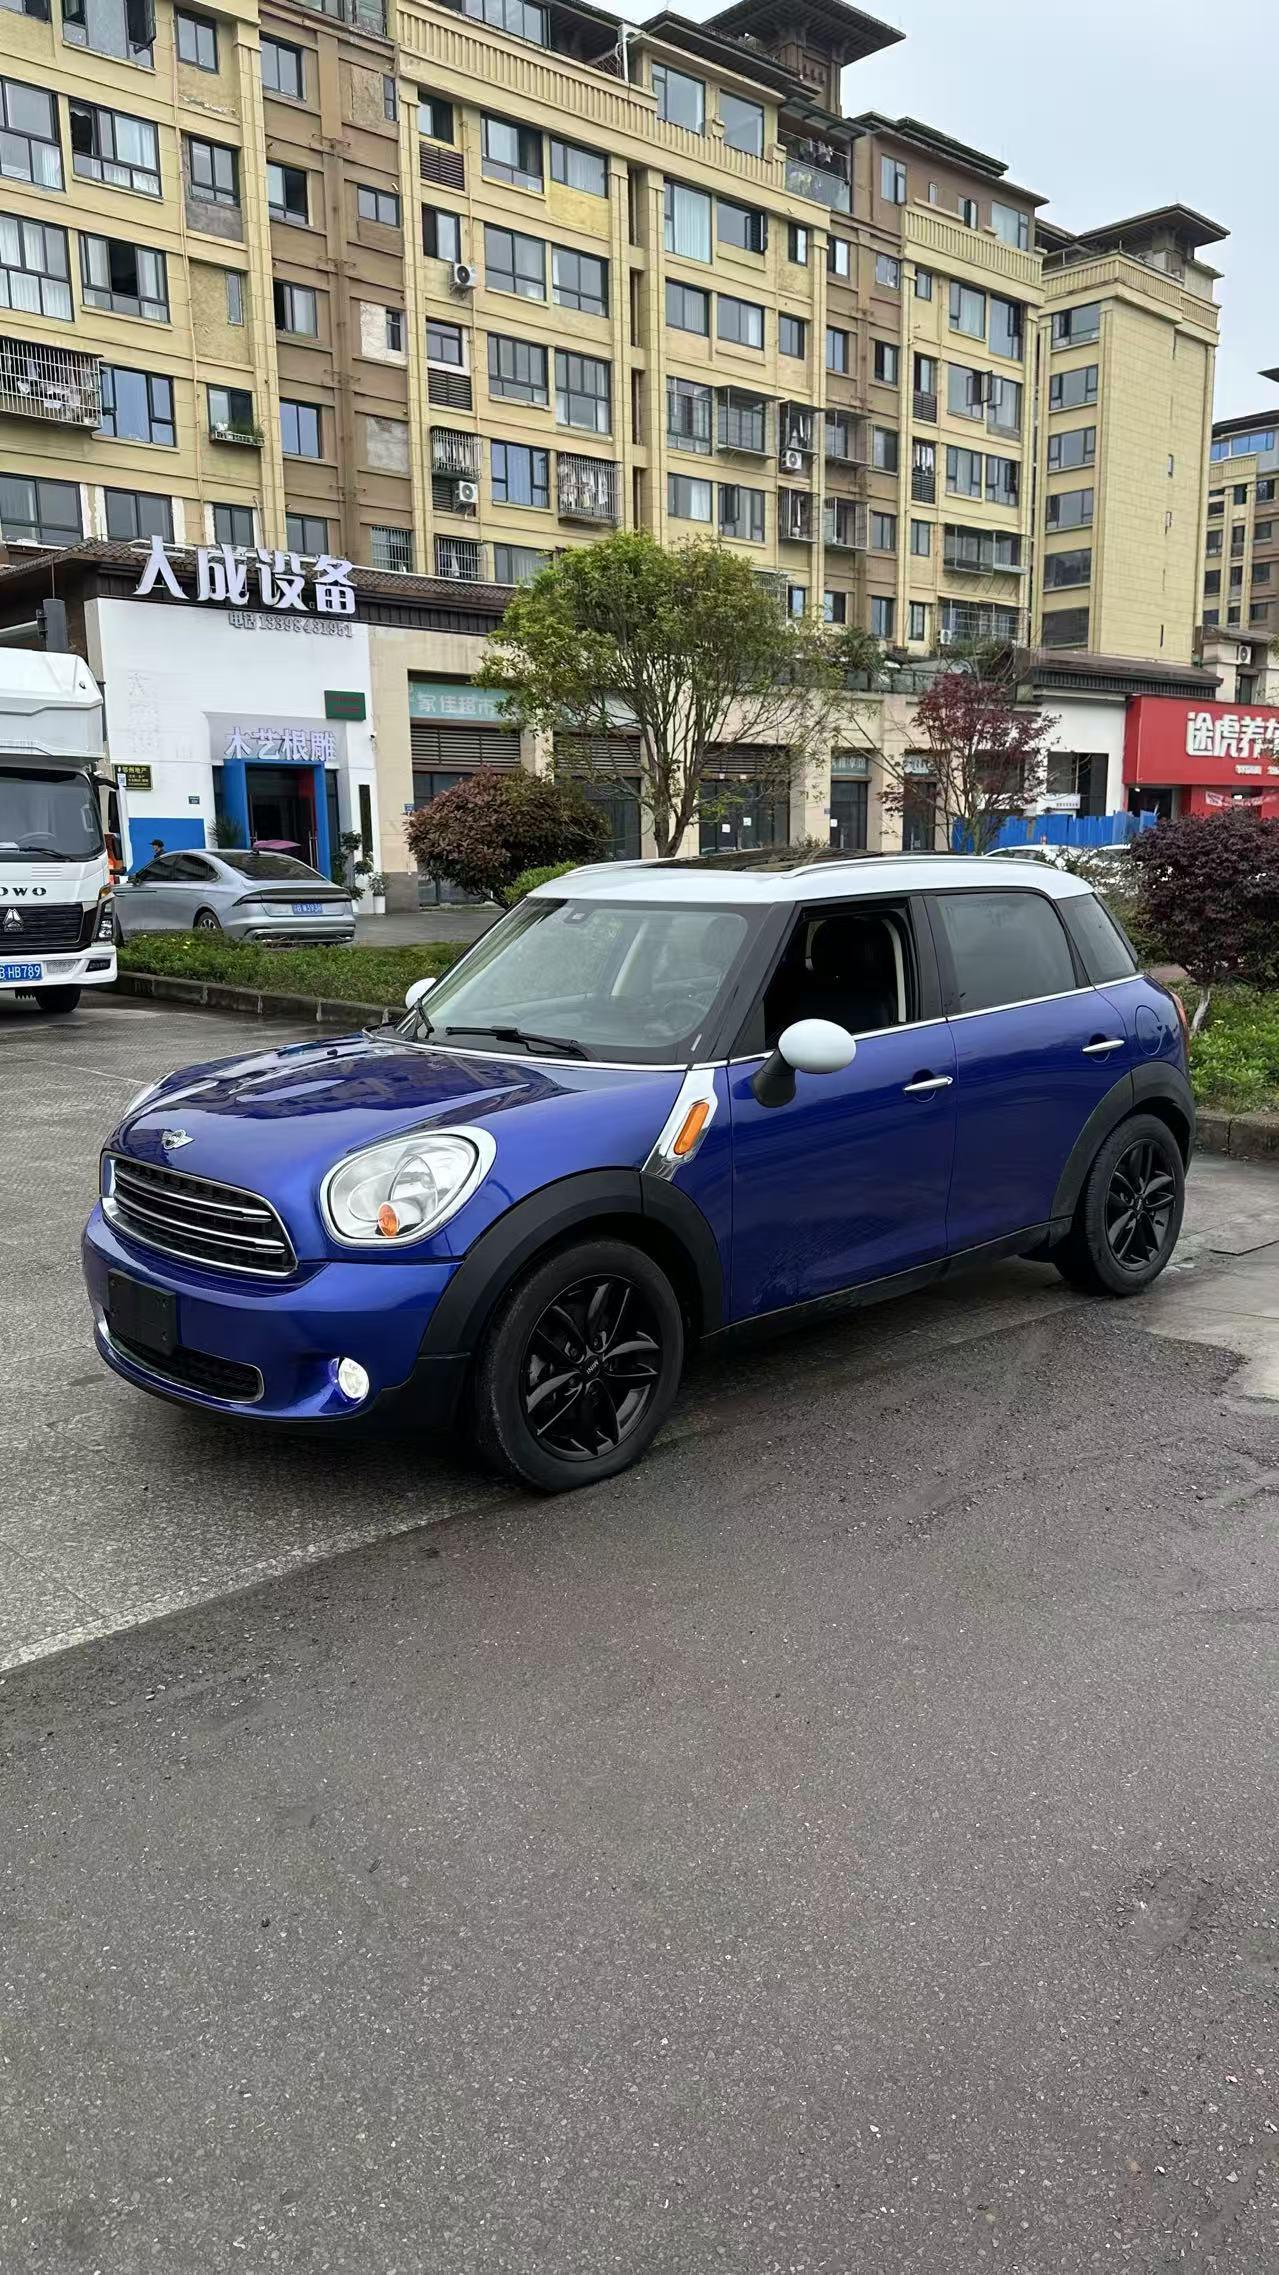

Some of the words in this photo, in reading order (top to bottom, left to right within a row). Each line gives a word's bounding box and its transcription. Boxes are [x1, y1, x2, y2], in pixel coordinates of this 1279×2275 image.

[132, 535, 357, 614] 大成设备
[229, 611, 256, 629] 电话
[224, 726, 337, 761] 木艺根雕
